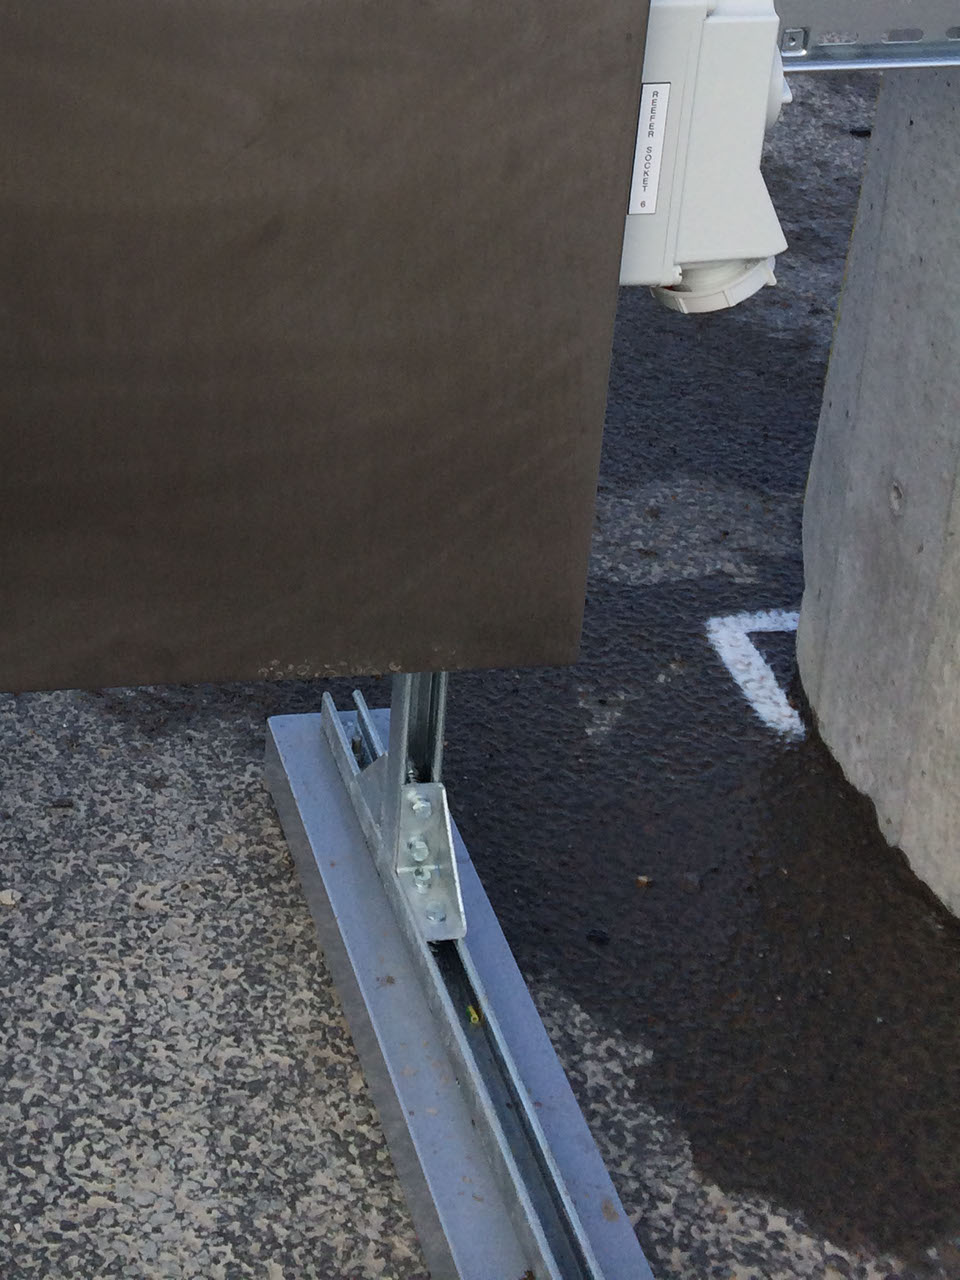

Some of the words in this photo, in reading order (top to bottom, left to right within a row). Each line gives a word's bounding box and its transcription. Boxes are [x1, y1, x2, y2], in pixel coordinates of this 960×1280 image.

[647, 90, 659, 138] REEFER
[642, 146, 652, 192] SOCKET
[640, 200, 646, 208] 6
